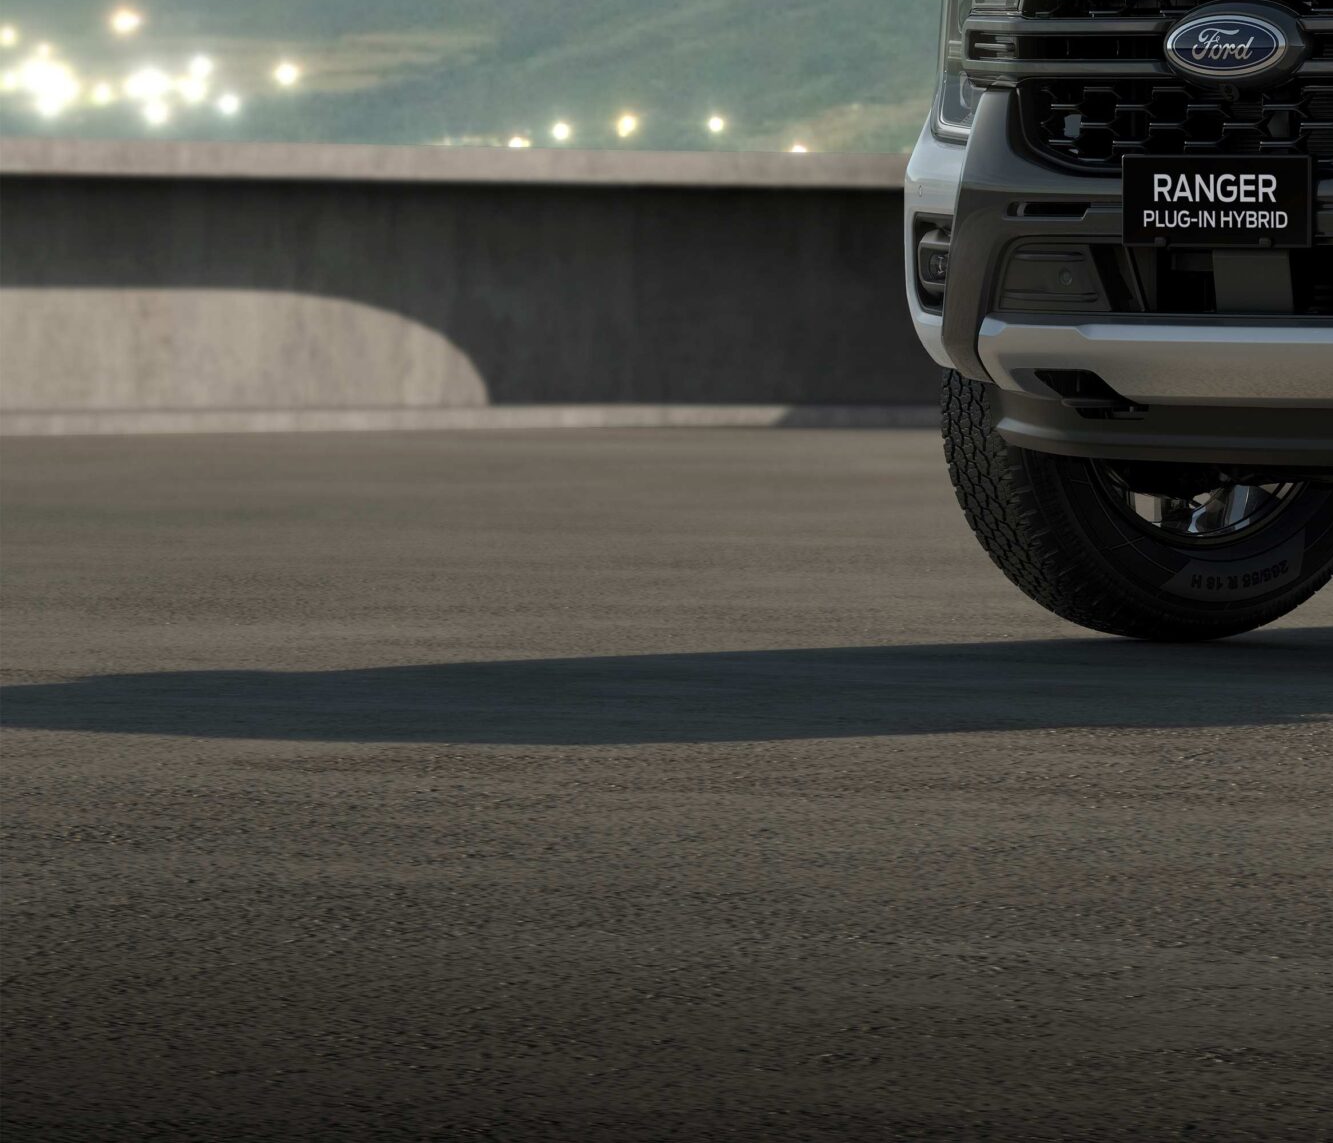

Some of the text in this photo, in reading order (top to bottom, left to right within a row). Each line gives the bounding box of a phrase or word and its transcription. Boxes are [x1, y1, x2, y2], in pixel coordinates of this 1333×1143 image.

[1191, 27, 1255, 61] Ford
[1153, 173, 1277, 203] RANGER
[1143, 210, 1288, 229] PLUG-IN HYBRID
